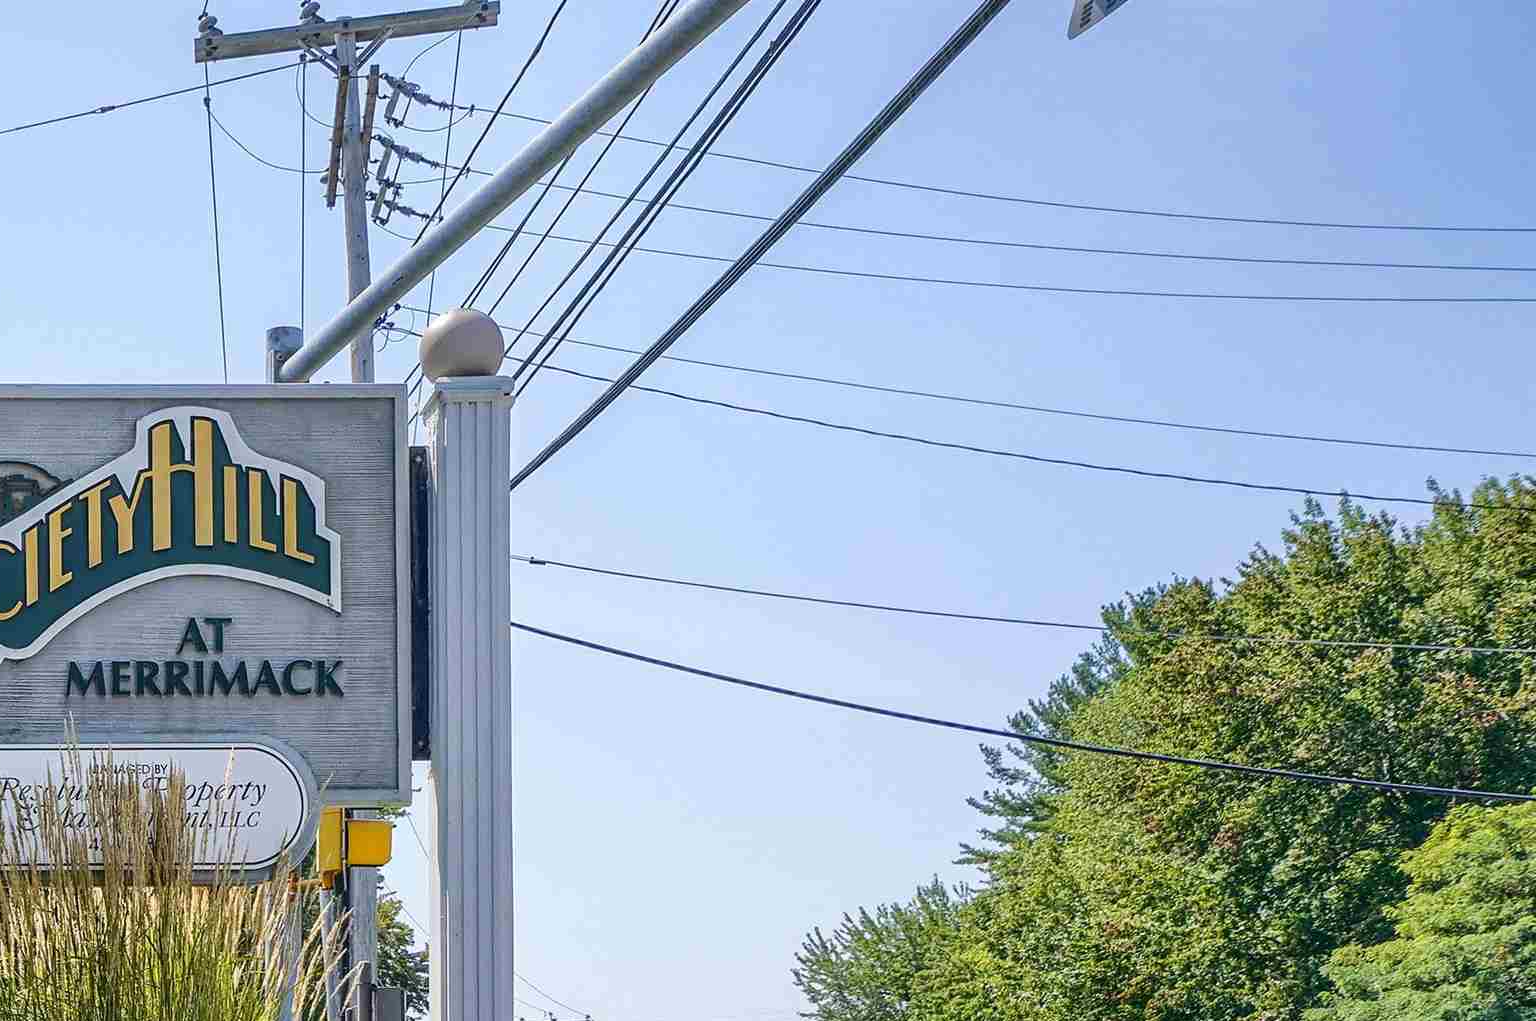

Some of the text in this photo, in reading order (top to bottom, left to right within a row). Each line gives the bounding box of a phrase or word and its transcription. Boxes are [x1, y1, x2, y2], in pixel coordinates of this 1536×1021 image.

[142, 416, 317, 565] HILL
[176, 616, 233, 655] AT
[65, 658, 345, 699] MERRIMACK
[154, 763, 168, 775] BY
[141, 776, 267, 807] Poperty
[219, 811, 261, 828] LLC
